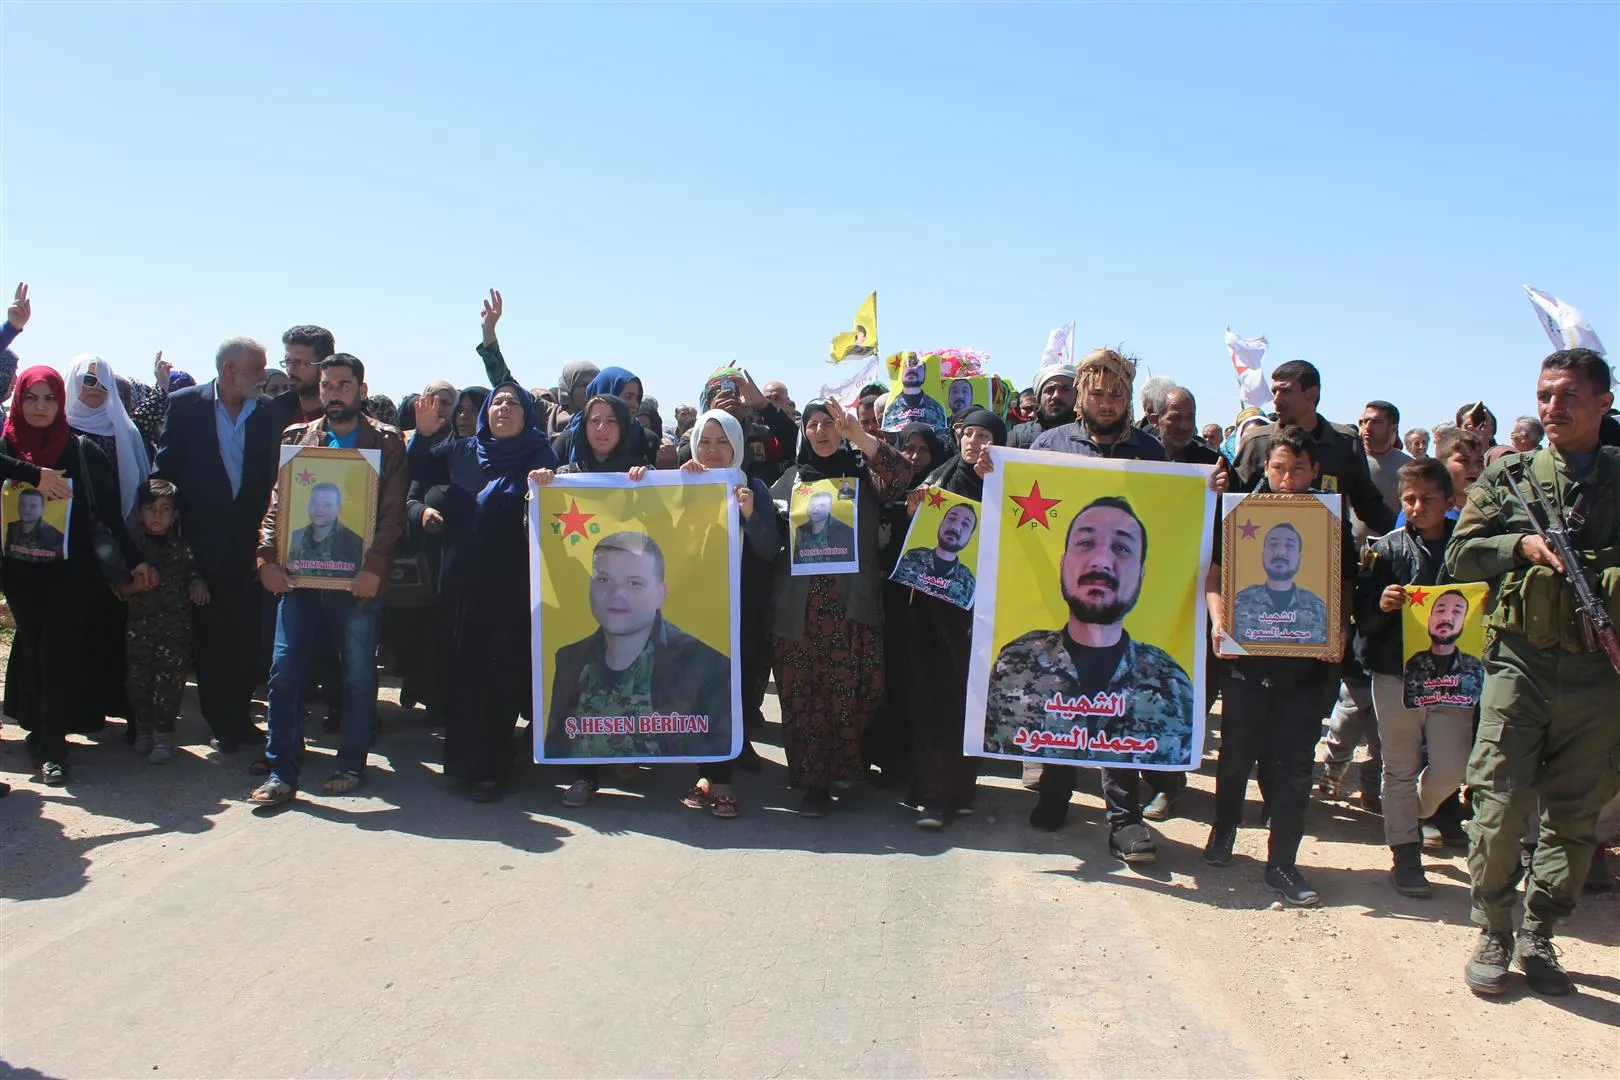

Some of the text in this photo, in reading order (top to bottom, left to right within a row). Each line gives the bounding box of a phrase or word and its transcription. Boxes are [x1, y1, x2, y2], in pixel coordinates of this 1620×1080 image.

[1258, 610, 1297, 624] الشهيد
[1244, 626, 1312, 639] محمد السعود
[1423, 675, 1459, 690] الشهيد
[1044, 691, 1126, 719] الشهيد
[1414, 690, 1472, 707] محمد السعود
[638, 711, 710, 733] BÊRÎTAN
[1013, 725, 1157, 753] محمد السعود
